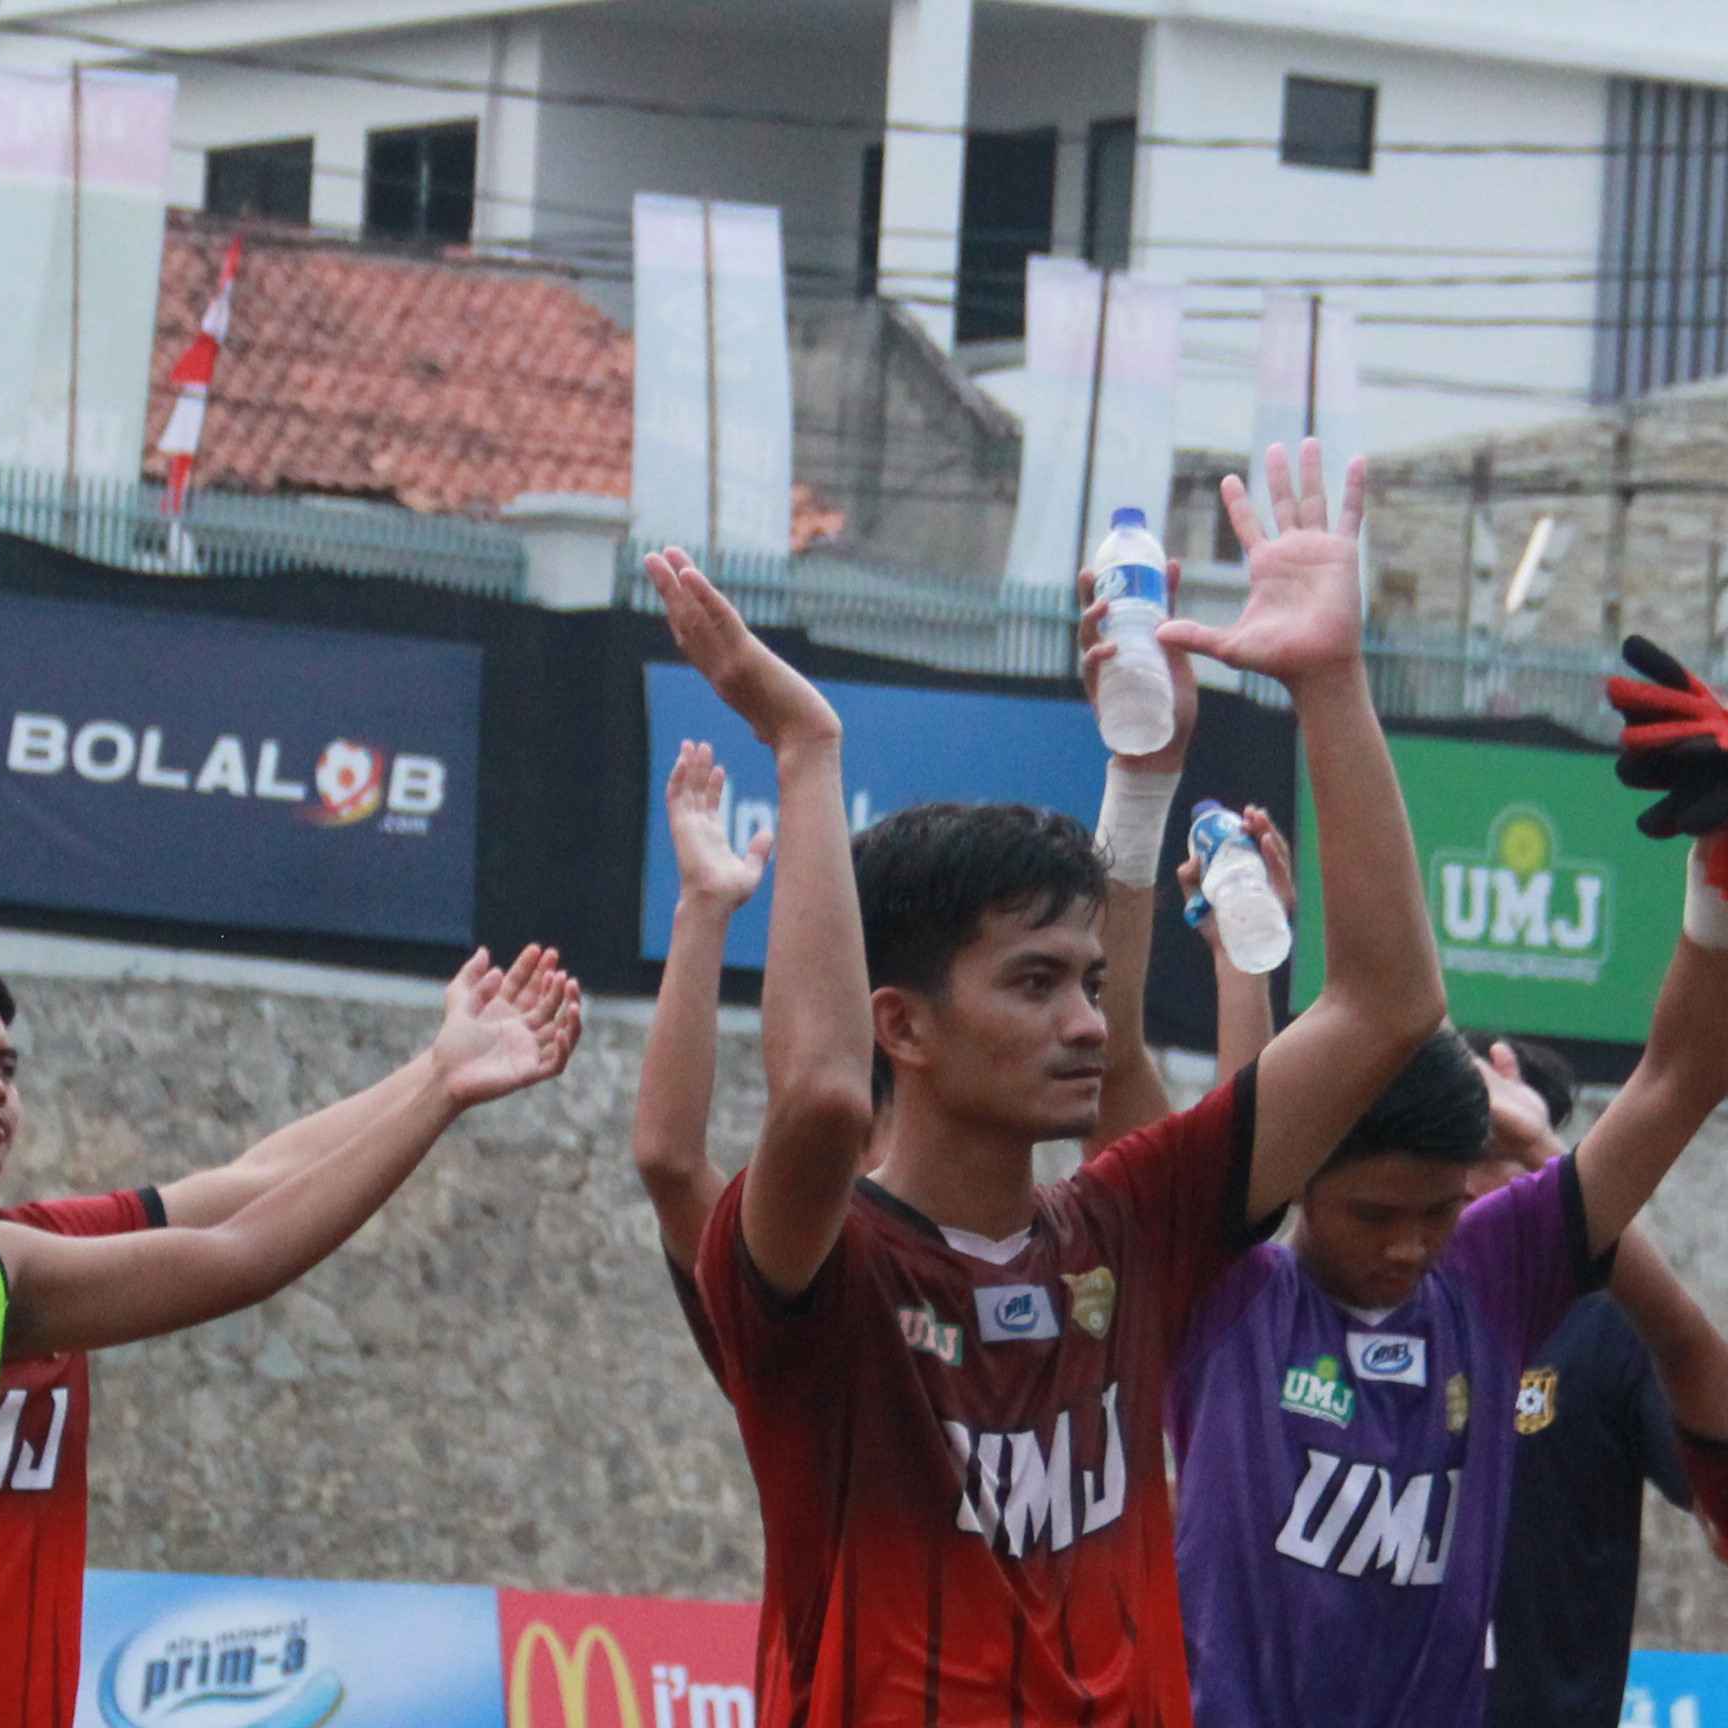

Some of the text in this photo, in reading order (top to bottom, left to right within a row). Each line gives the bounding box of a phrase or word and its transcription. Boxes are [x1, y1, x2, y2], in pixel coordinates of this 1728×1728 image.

[1441, 864, 1601, 949] UMJ
[1282, 1369, 1353, 1416] UMJ
[941, 1381, 1126, 1559] UMJ
[1275, 1449, 1462, 1587] UMJ
[140, 1637, 308, 1713] prim-a
